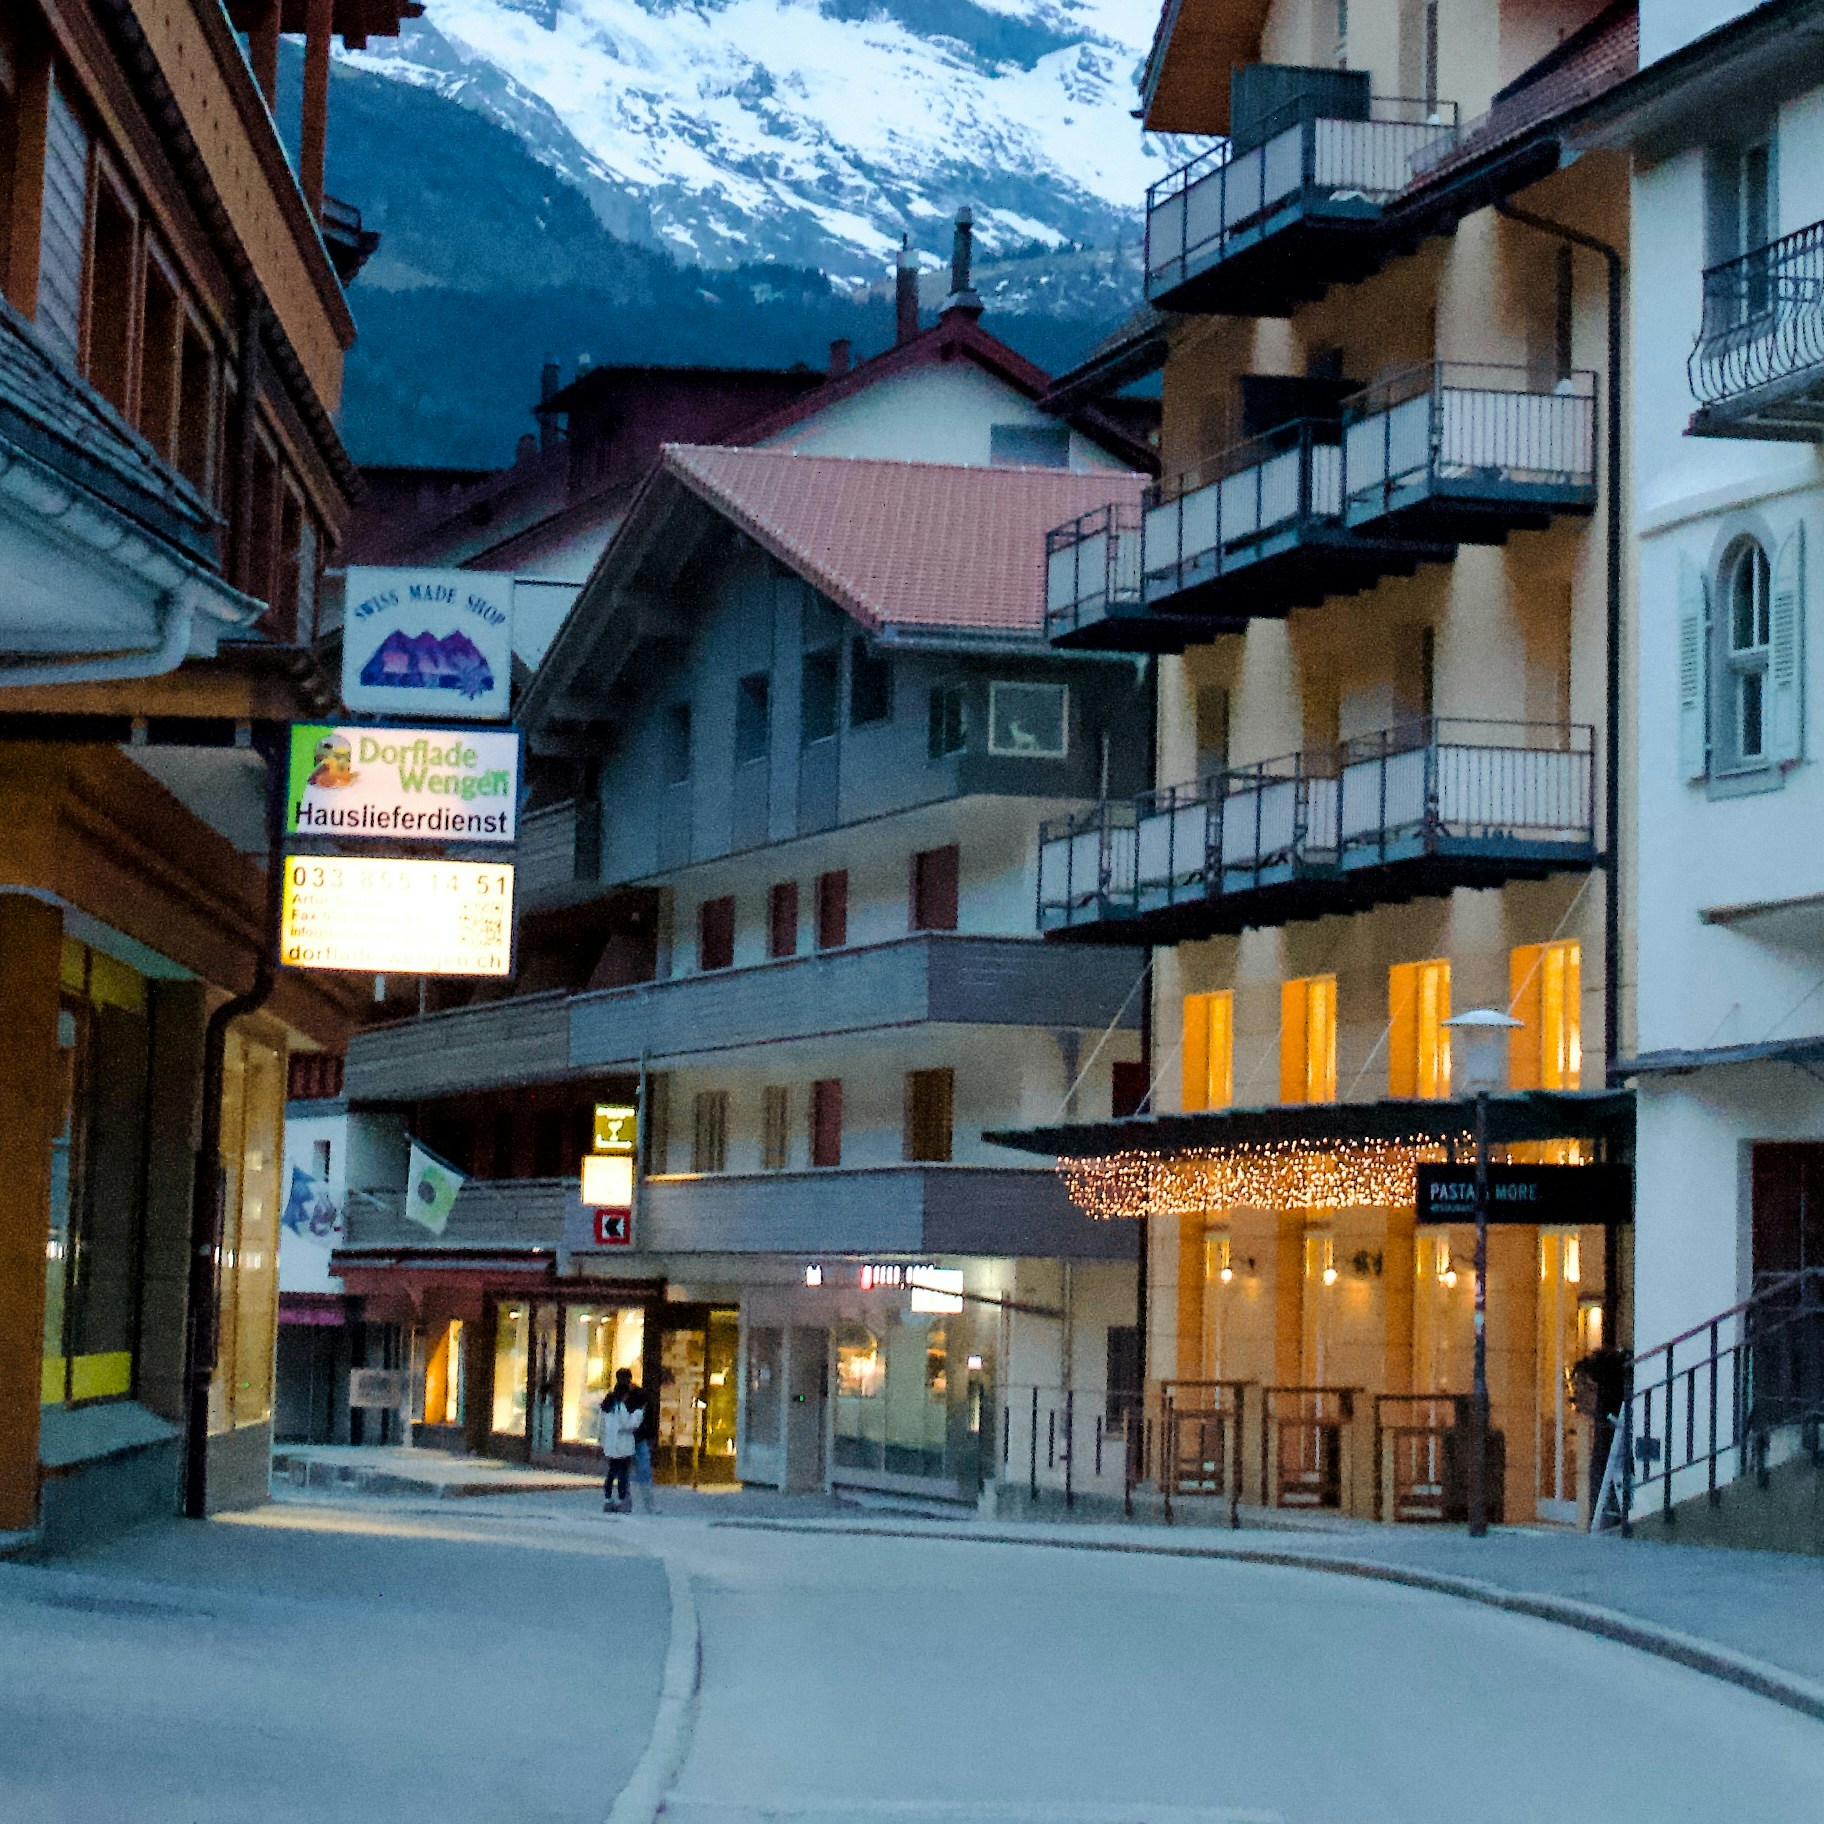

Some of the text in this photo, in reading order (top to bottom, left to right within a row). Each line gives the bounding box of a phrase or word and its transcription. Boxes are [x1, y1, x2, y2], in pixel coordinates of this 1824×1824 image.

[354, 584, 506, 626] SWISS MADE SHOP
[359, 736, 478, 768] Dorflade
[399, 766, 511, 801] Wengen
[295, 801, 508, 834] Hauslieferdienst
[293, 866, 344, 889] 033
[477, 874, 505, 896] 51
[292, 908, 318, 922] Fax
[1430, 1182, 1476, 1200] PASTA
[1495, 1182, 1538, 1201] MORE
